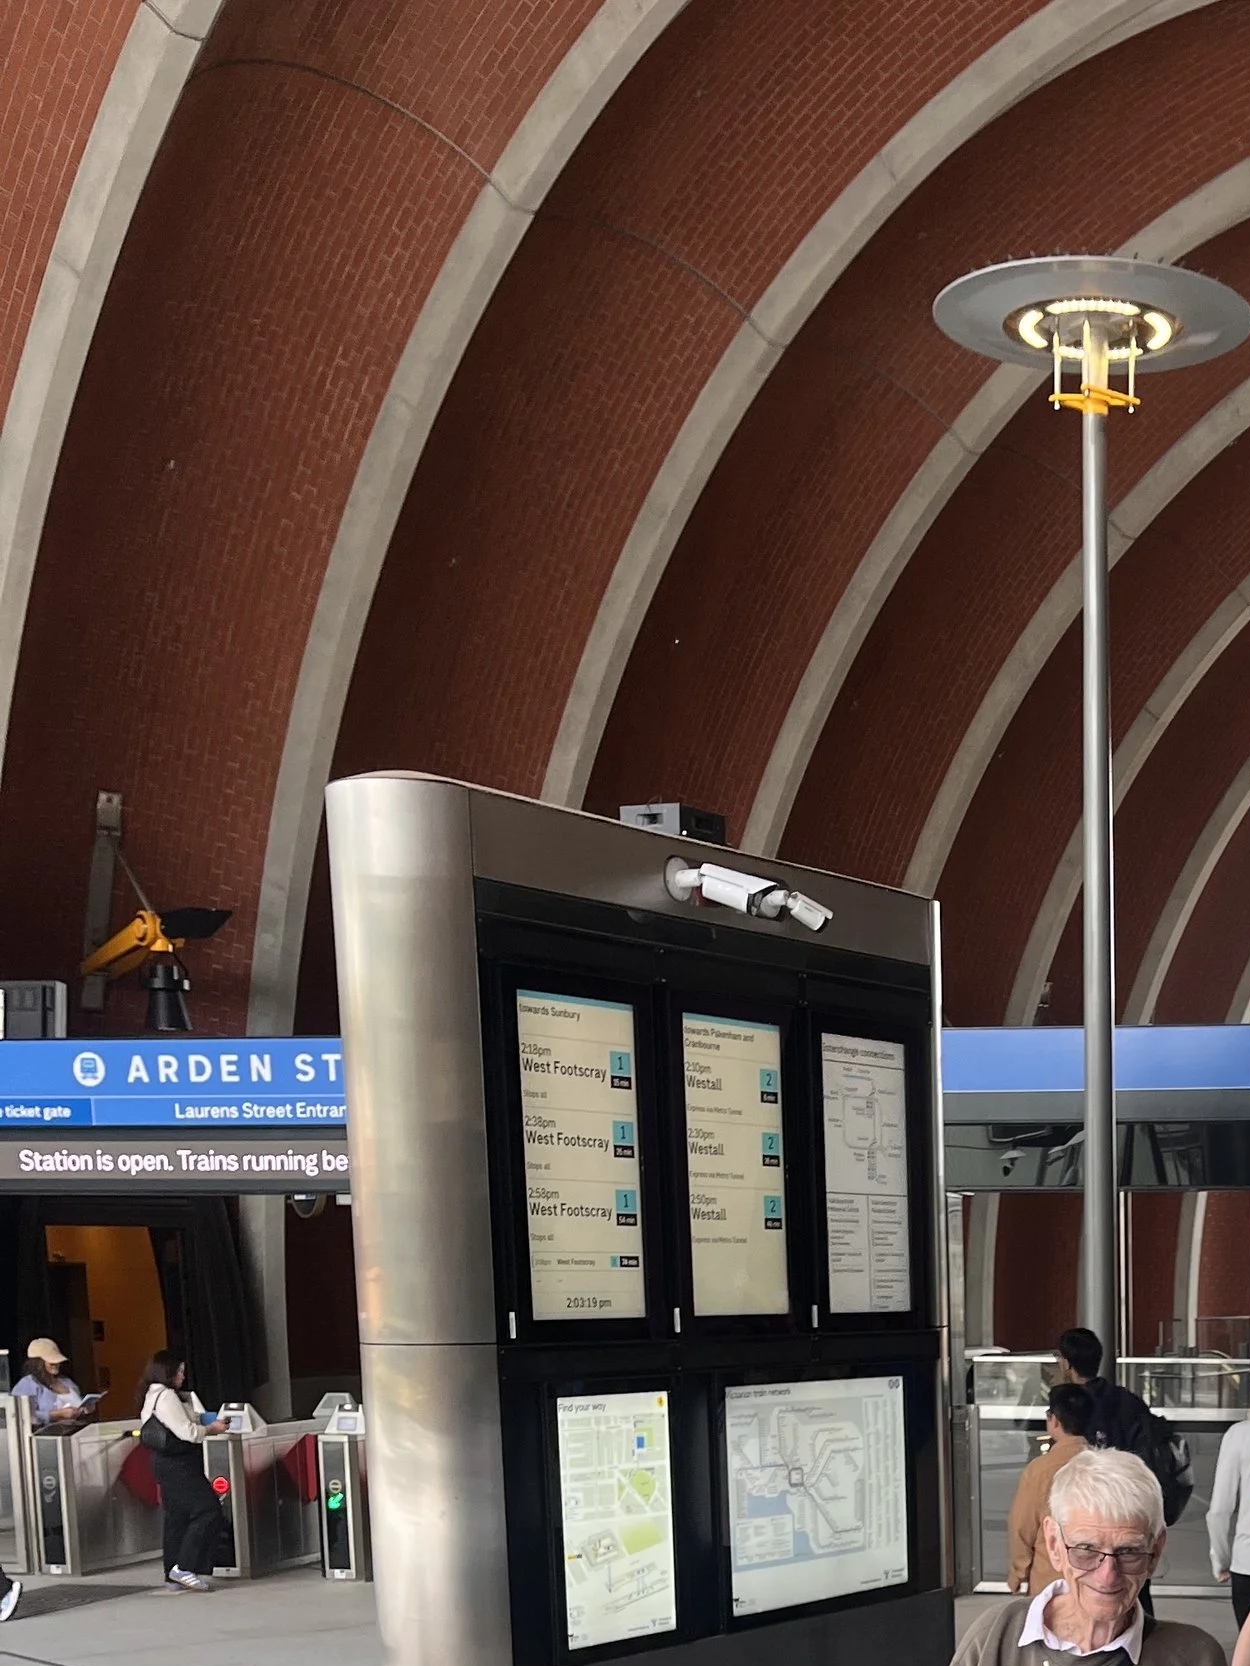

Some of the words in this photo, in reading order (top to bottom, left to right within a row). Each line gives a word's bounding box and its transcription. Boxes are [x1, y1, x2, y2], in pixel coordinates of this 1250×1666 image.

[519, 1003, 549, 1016] towards
[550, 1007, 581, 1022] Sunbury
[128, 1054, 272, 1083] ARDEN
[522, 1057, 551, 1074] West
[553, 1061, 607, 1083] Footscray
[617, 1056, 624, 1070] 1
[686, 1075, 722, 1091] Westall
[766, 1073, 772, 1087] 2
[5, 1105, 41, 1118] ticket
[43, 1106, 72, 1120] gate
[174, 1103, 240, 1119] Laurens
[242, 1103, 293, 1119] Street
[620, 1125, 626, 1140] 1
[526, 1130, 555, 1146] West
[557, 1132, 610, 1153] Footscray
[688, 1142, 725, 1156] Westall
[768, 1136, 774, 1150] 2
[18, 1149, 94, 1172] Station
[96, 1149, 115, 1172] is
[117, 1151, 174, 1176] open.
[176, 1150, 240, 1172] Trains
[243, 1150, 319, 1177] running
[623, 1194, 629, 1209] 1
[770, 1200, 776, 1213] 2
[529, 1202, 558, 1217] West
[560, 1203, 613, 1222] Footscray
[691, 1207, 727, 1221] Westall
[566, 1297, 598, 1309] 2:03:19
[599, 1298, 612, 1310] pm
[558, 1403, 573, 1413] Find
[574, 1403, 590, 1414] your
[592, 1403, 607, 1413] way
